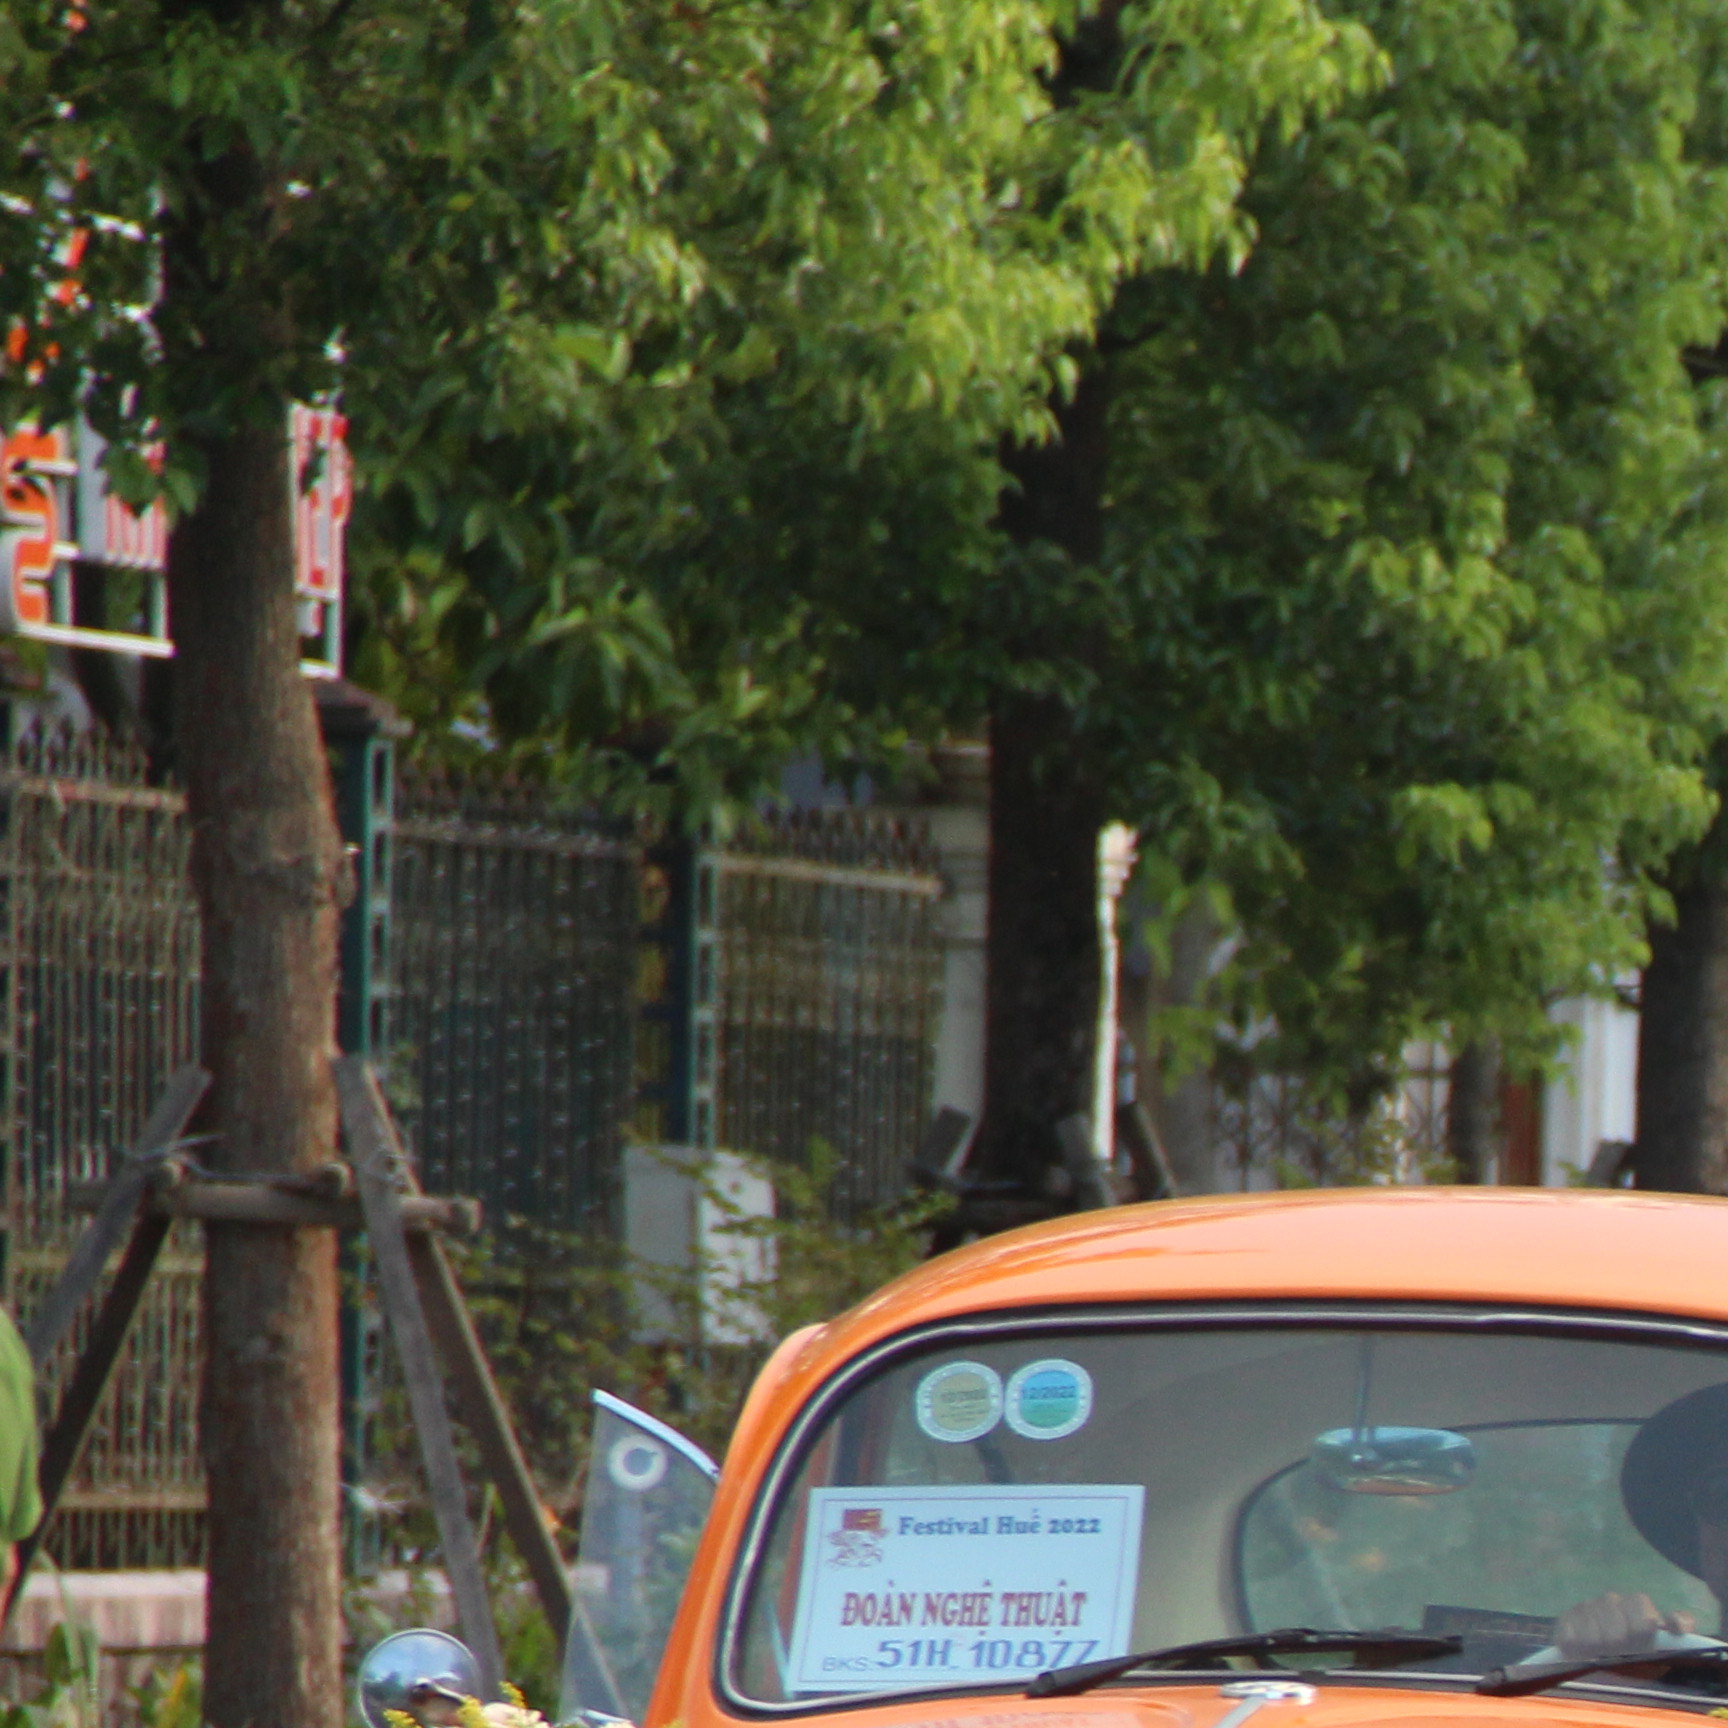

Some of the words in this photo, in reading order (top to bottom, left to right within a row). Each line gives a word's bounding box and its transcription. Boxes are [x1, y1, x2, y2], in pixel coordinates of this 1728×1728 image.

[899, 1516, 989, 1535] Festival
[1048, 1517, 1101, 1534] 2022
[840, 1579, 917, 1627] ĐOÀN
[921, 1579, 993, 1637] NGHỆ
[1001, 1579, 1087, 1636] THUẬT
